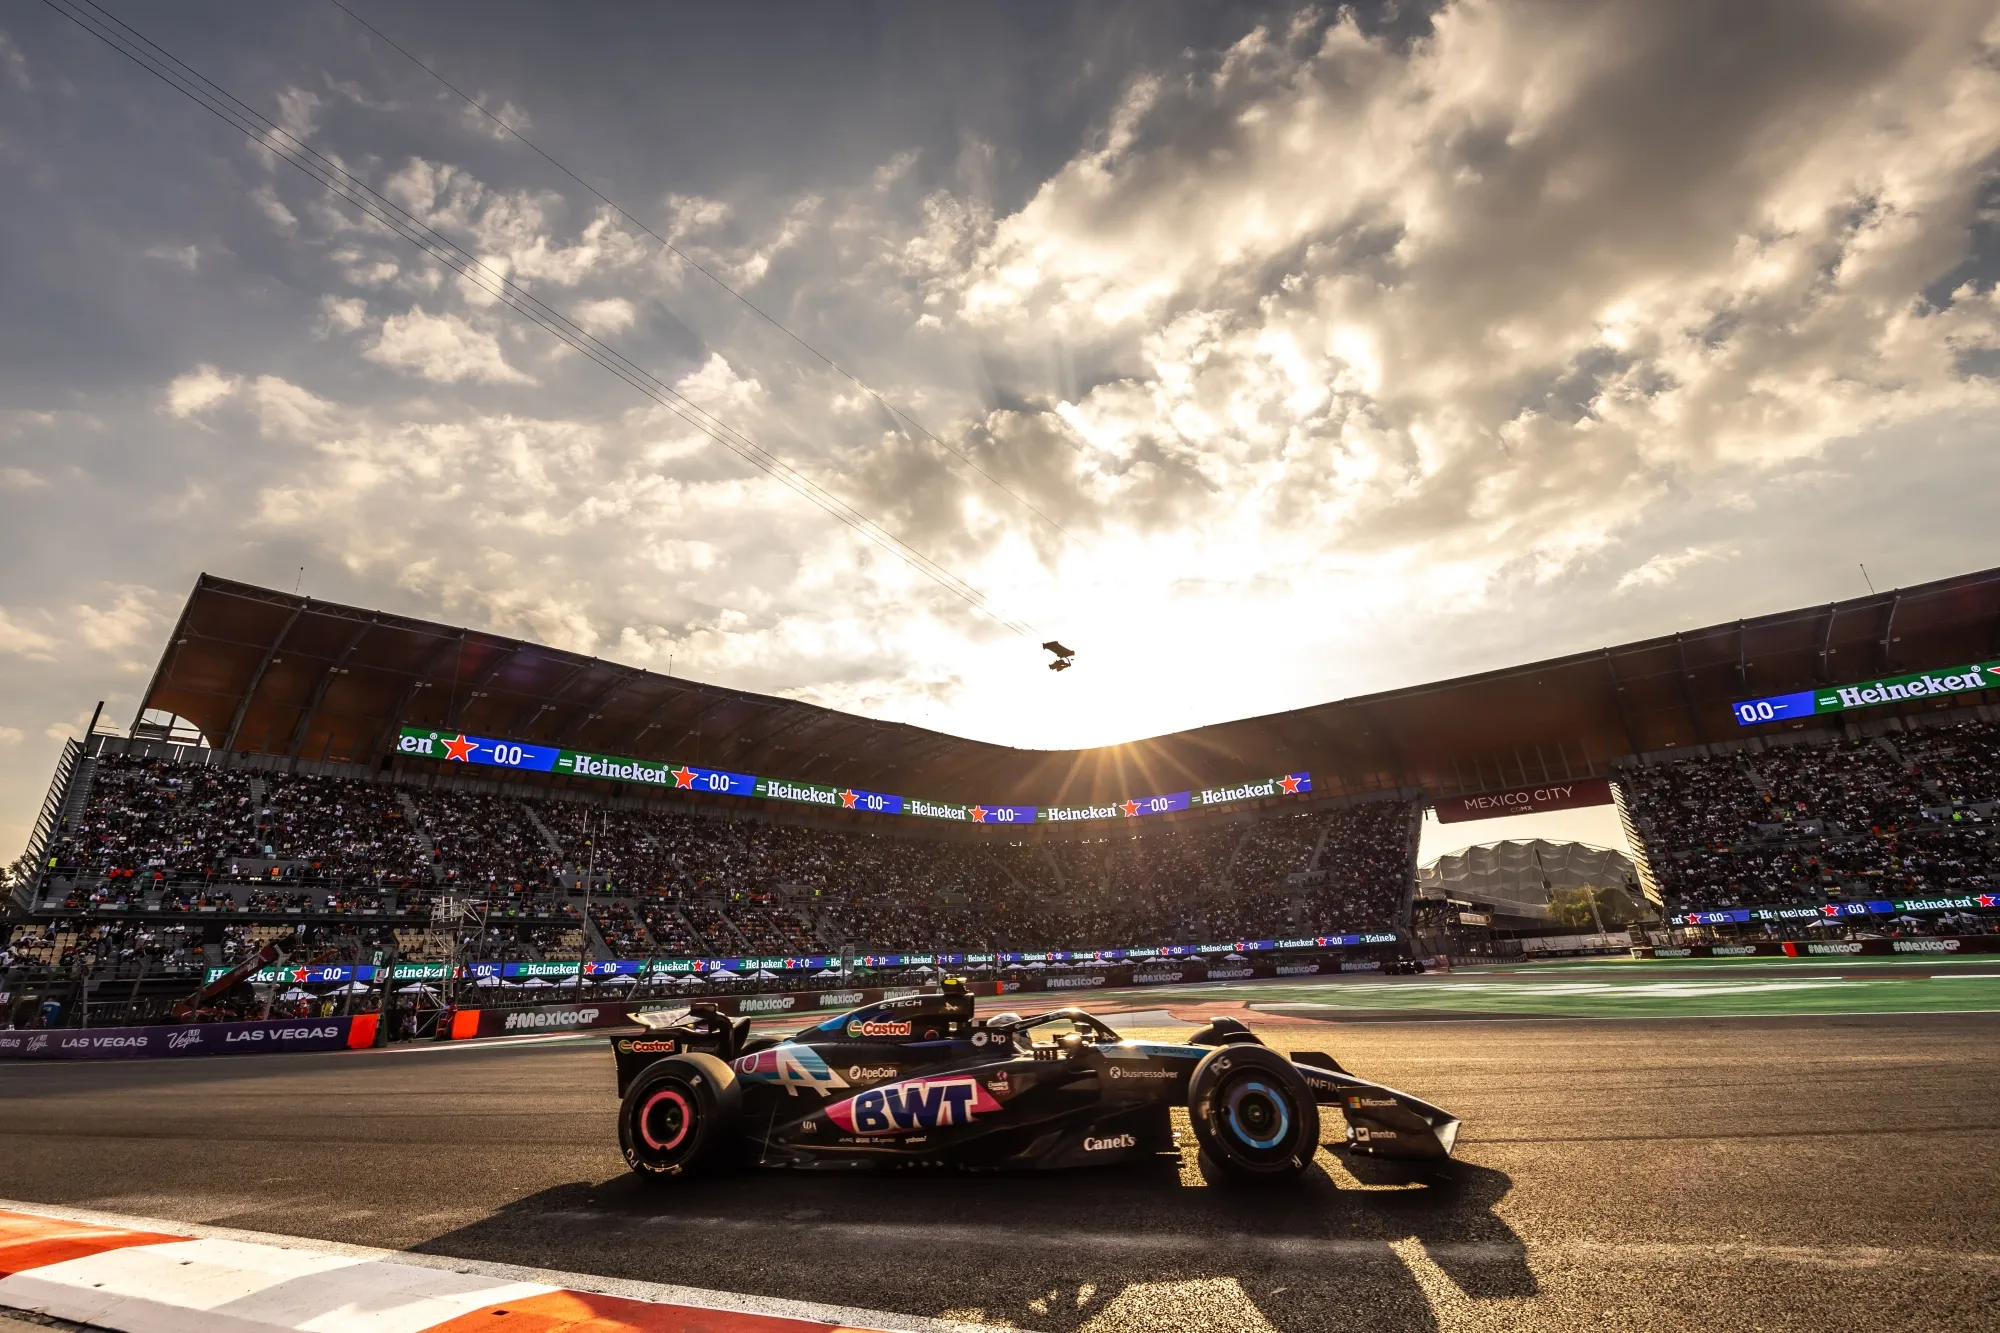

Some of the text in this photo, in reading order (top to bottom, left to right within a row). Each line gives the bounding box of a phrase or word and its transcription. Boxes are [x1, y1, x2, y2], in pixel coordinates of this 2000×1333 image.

[1836, 671, 1987, 708] Heineken
[573, 755, 667, 783] Heineken
[767, 781, 836, 804] Heineken
[911, 801, 966, 820] Heineken
[1047, 806, 1117, 821] Heineken
[1201, 782, 1275, 804] Heineken
[1464, 786, 1573, 810] MEXICO CITY
[527, 964, 579, 975] Heineken
[740, 997, 795, 1011] #MexicoGP
[505, 1009, 599, 1029] #MexicoGP
[226, 1026, 339, 1042] LAS VEGAS
[862, 1020, 912, 1036] Castrol
[61, 1036, 148, 1048] LAS VEGAS
[631, 1040, 675, 1053] Castrol
[991, 1032, 1006, 1045] bp
[861, 1068, 897, 1079] ApeCoin
[1122, 1068, 1179, 1079] businessolver
[853, 1081, 976, 1133] BWT
[1083, 1133, 1136, 1151] Canel's
